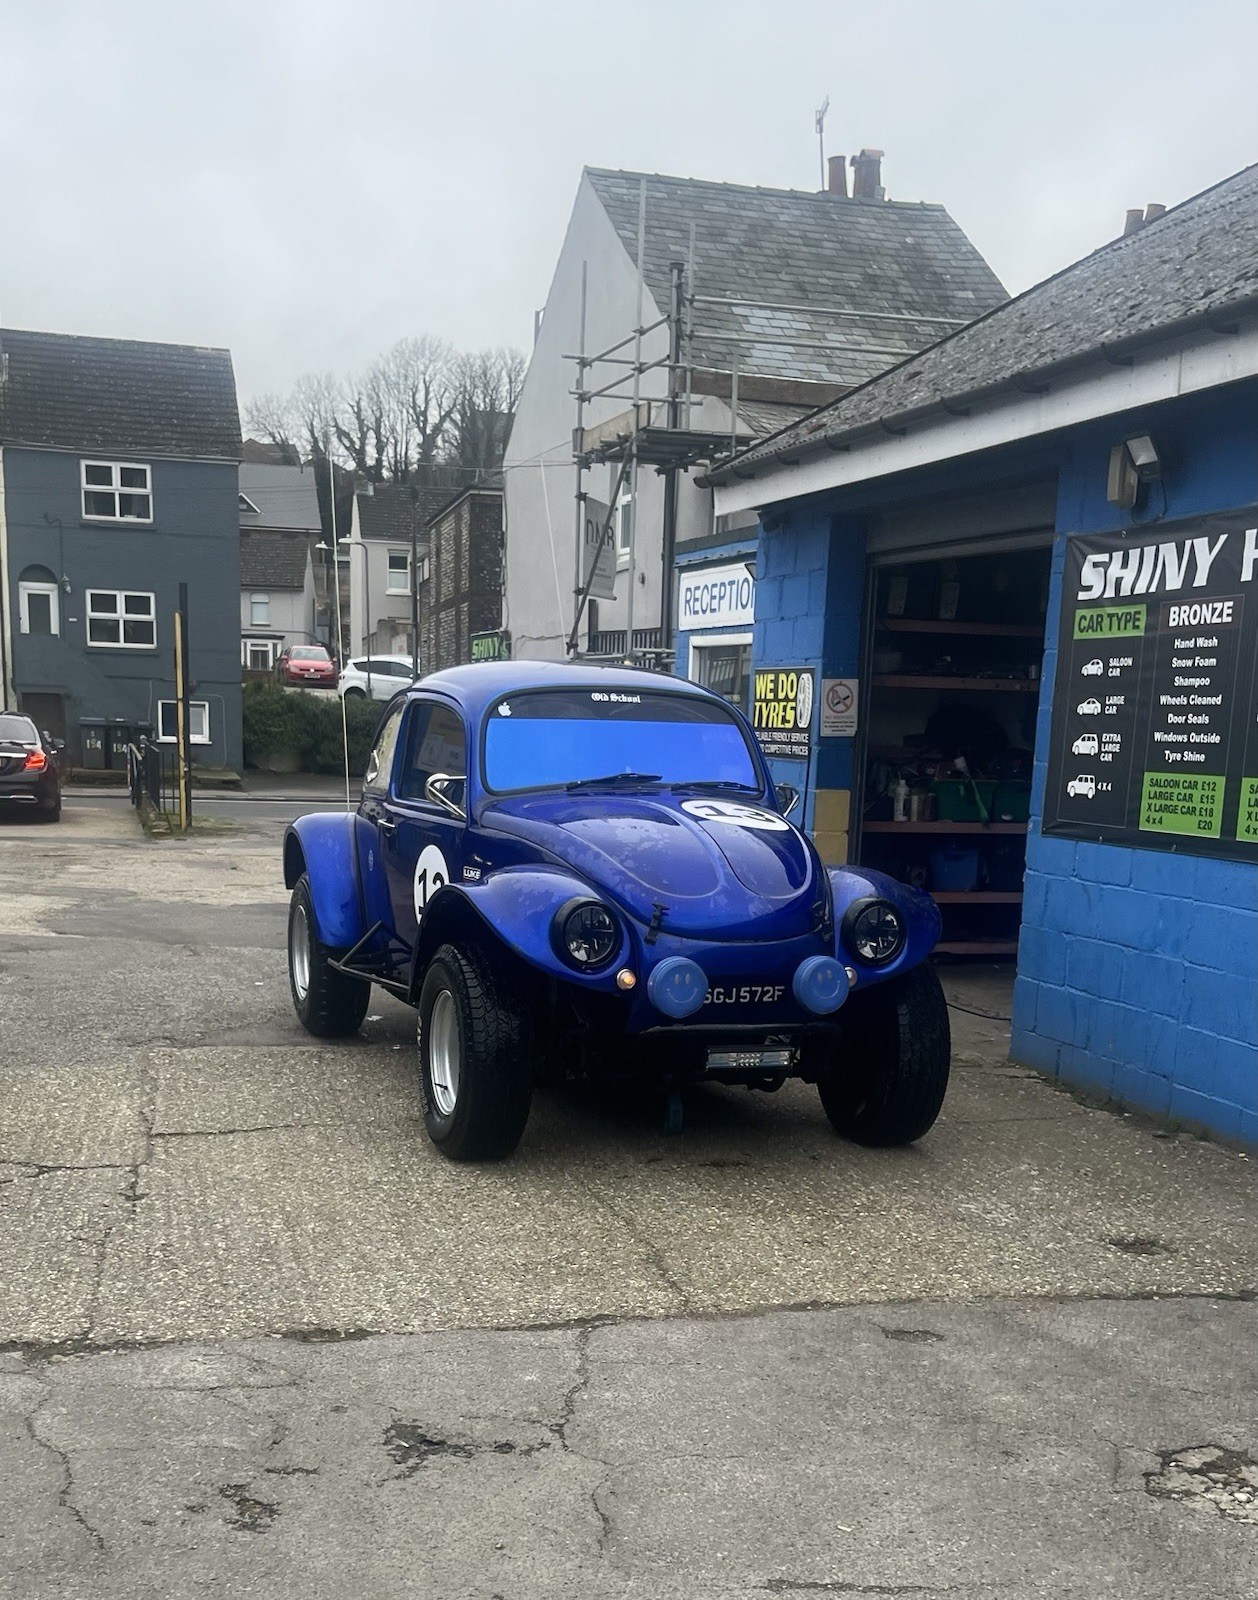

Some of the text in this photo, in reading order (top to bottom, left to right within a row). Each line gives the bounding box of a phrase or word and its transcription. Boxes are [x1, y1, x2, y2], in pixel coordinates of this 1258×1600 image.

[1077, 533, 1229, 601] SHINY
[684, 576, 755, 617] RECEPTIO
[1169, 601, 1234, 627] BRONZE
[1078, 610, 1142, 633] CAR TYPE
[1174, 636, 1218, 649] Hand Wash
[1108, 657, 1133, 667] SALOON
[1172, 656, 1217, 668] Snow Foam
[1107, 668, 1121, 677] CAR
[755, 672, 797, 699] WE DO
[1174, 675, 1210, 688] Shampoo
[591, 692, 641, 703] Old School
[1105, 695, 1125, 705] LARGE
[1160, 694, 1222, 705] Wheels Cleaned
[754, 701, 796, 728] TYRES
[1104, 706, 1117, 714] CAR
[1167, 713, 1210, 724] Door Seals
[1102, 733, 1121, 742] EXTRA
[1154, 731, 1221, 744] Windows Outside
[1101, 743, 1120, 752] LARGE
[1100, 753, 1113, 762] CAR
[1164, 750, 1205, 763] Tyre Shine
[1149, 778, 1217, 792] SALOON CAR £12
[1148, 790, 1216, 805] LARGE CAR £15
[694, 805, 778, 824] 13
[1146, 803, 1214, 818] X LARGE CAR £18
[1197, 820, 1213, 830] £20
